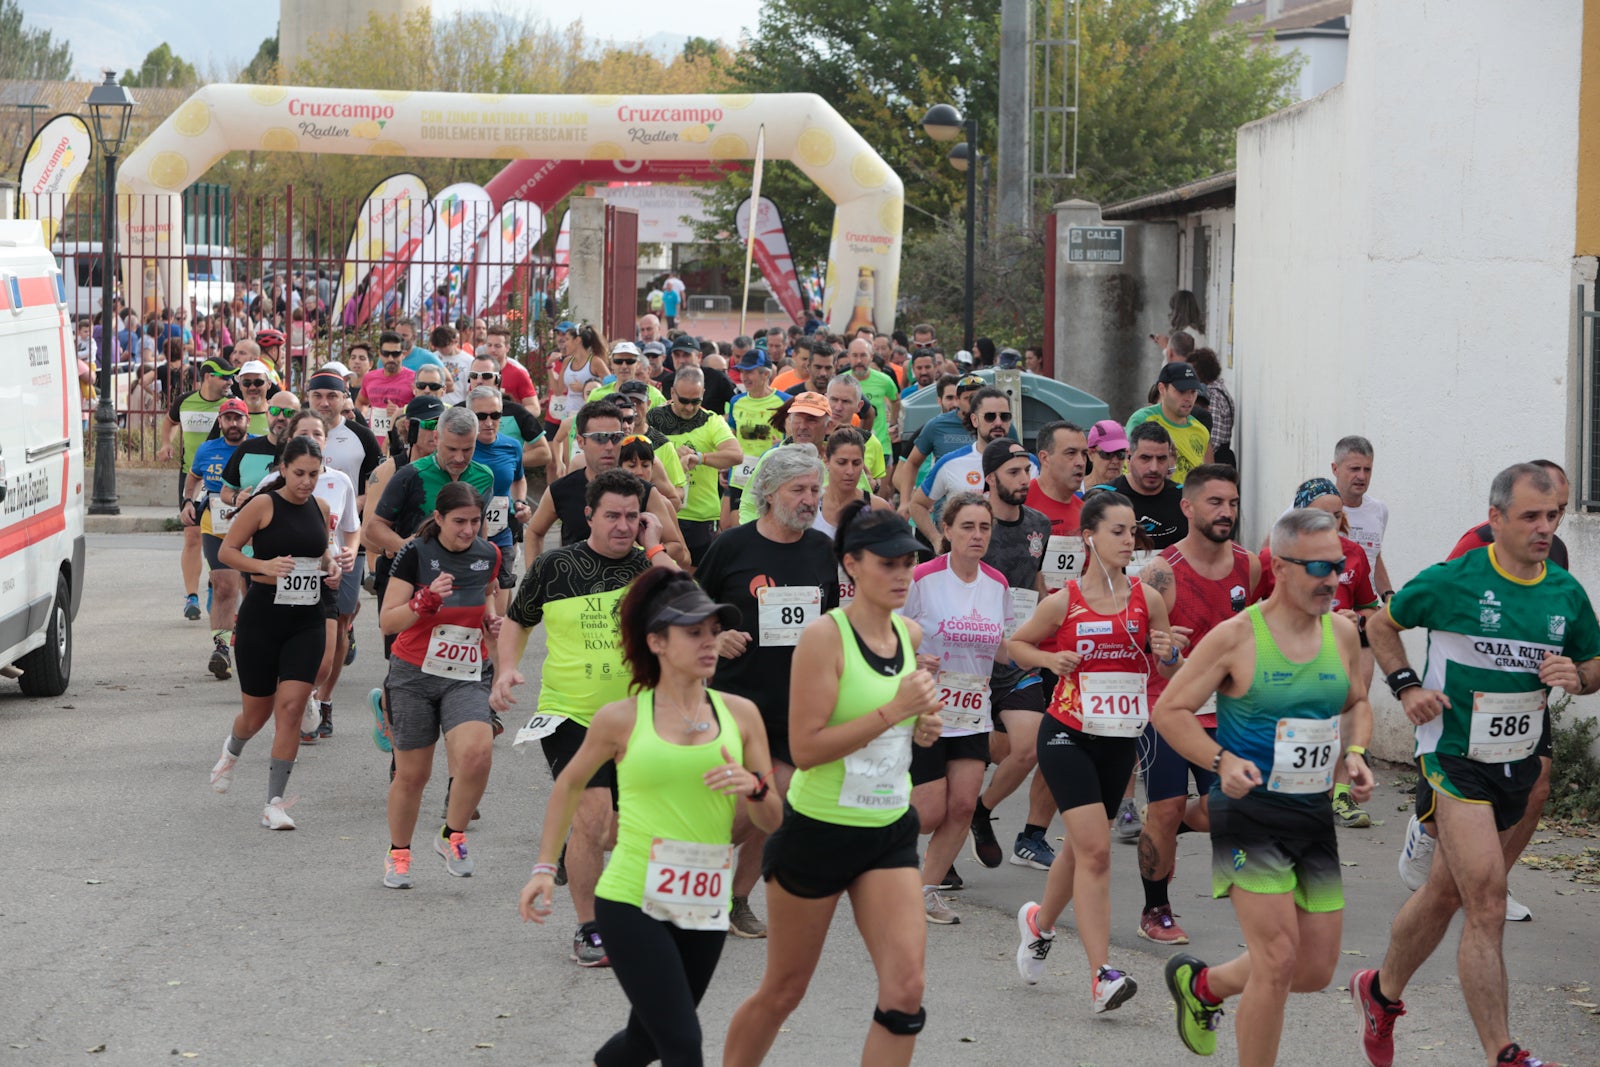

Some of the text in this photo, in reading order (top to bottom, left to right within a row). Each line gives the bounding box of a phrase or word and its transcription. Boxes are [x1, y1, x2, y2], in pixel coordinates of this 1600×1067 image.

[288, 98, 394, 120] Cruzcampo
[420, 110, 443, 124] CON
[446, 110, 478, 124] ZUMO
[481, 111, 531, 125] NATURAL
[535, 111, 550, 125] DE
[617, 104, 723, 124] Cruzcampo
[298, 121, 350, 139] Radler
[420, 126, 588, 142] DOBLEMENTE REFRESCANTE
[627, 127, 679, 145] Radler
[32, 136, 70, 196] Cruzcampo
[1087, 231, 1117, 240] CALLE
[206, 463, 223, 475] 45
[1057, 554, 1075, 570] 92
[283, 575, 317, 591] 3076
[583, 597, 602, 612] XI
[580, 613, 607, 621] Prueba
[781, 606, 804, 625] 89
[581, 620, 608, 630] Fondo
[435, 641, 478, 663] 2070
[584, 639, 616, 650] ROM
[1475, 641, 1514, 657] CAJA
[939, 688, 982, 710] 2166
[1090, 695, 1140, 716] 2101
[1488, 714, 1530, 738] 586
[1292, 744, 1331, 769] 318
[656, 868, 722, 898] 2180
